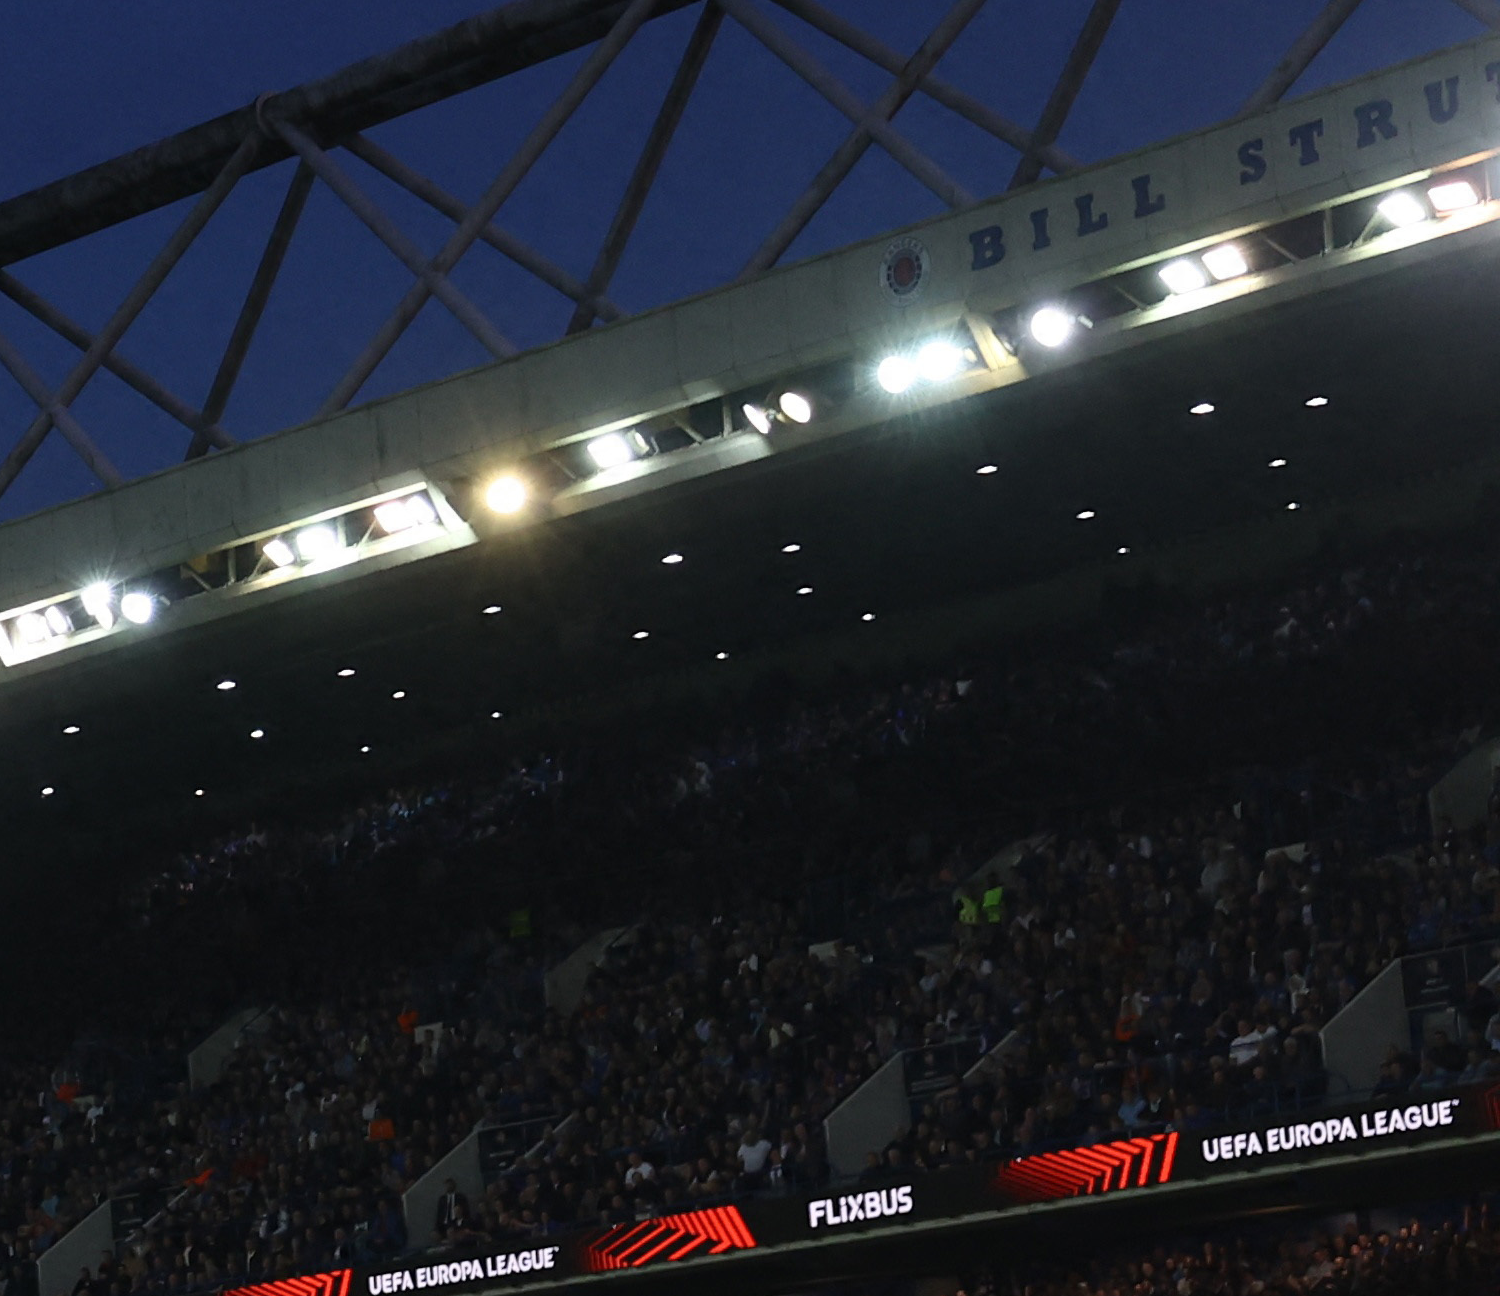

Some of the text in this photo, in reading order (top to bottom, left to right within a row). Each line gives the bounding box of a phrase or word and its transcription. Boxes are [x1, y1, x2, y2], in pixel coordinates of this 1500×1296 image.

[969, 173, 1166, 271] BILL
[1200, 1130, 1262, 1164] UEFA
[1265, 1116, 1357, 1154] EUROPA
[367, 1271, 414, 1296] UEFA
[415, 1259, 485, 1291] EUROPA
